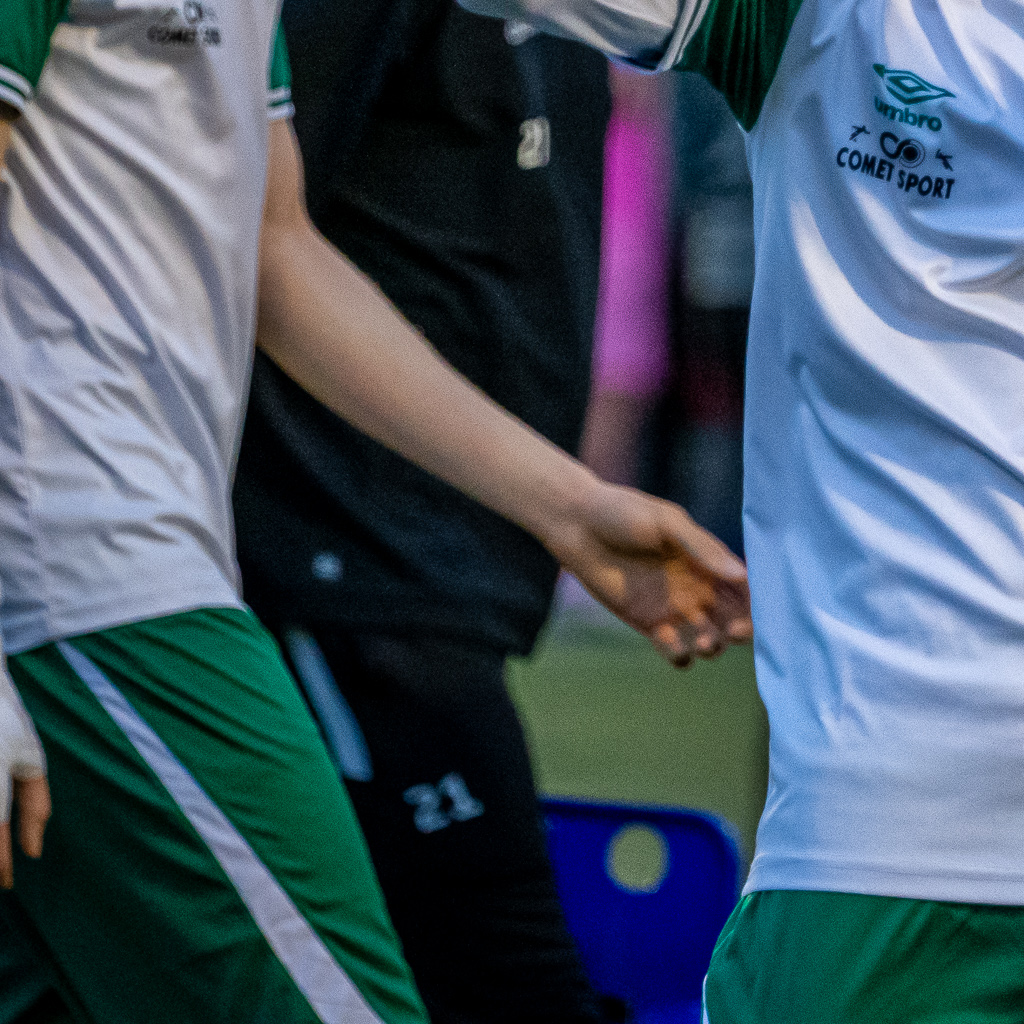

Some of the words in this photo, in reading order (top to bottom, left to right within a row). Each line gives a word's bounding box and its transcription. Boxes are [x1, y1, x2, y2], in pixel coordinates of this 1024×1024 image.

[873, 95, 943, 132] umbro
[836, 146, 895, 183] COMET
[897, 169, 956, 200] SPORT
[402, 771, 485, 834] 21
